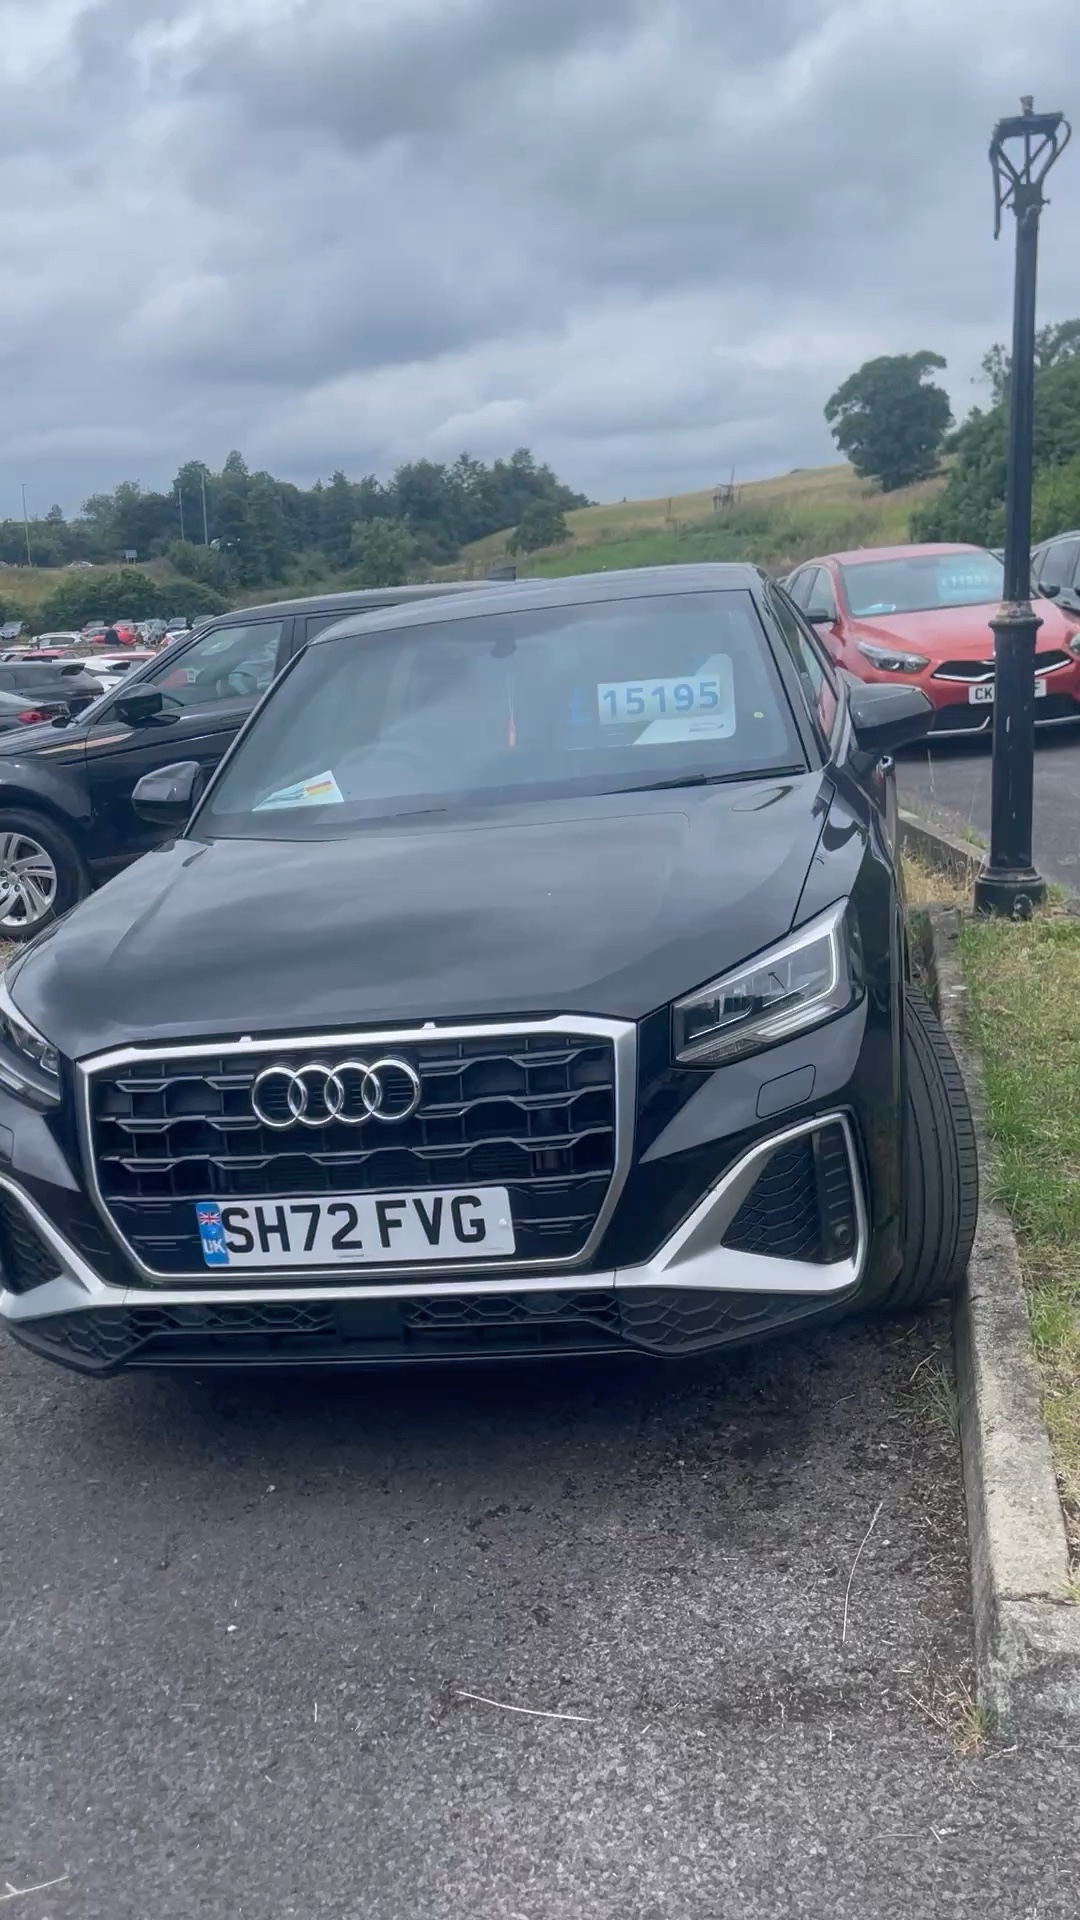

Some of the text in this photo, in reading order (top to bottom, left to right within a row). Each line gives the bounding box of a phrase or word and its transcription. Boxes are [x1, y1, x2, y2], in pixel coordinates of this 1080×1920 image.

[602, 682, 719, 716] 15195
[221, 1195, 486, 1253] SH72 FVG
[203, 1238, 226, 1254] UK
